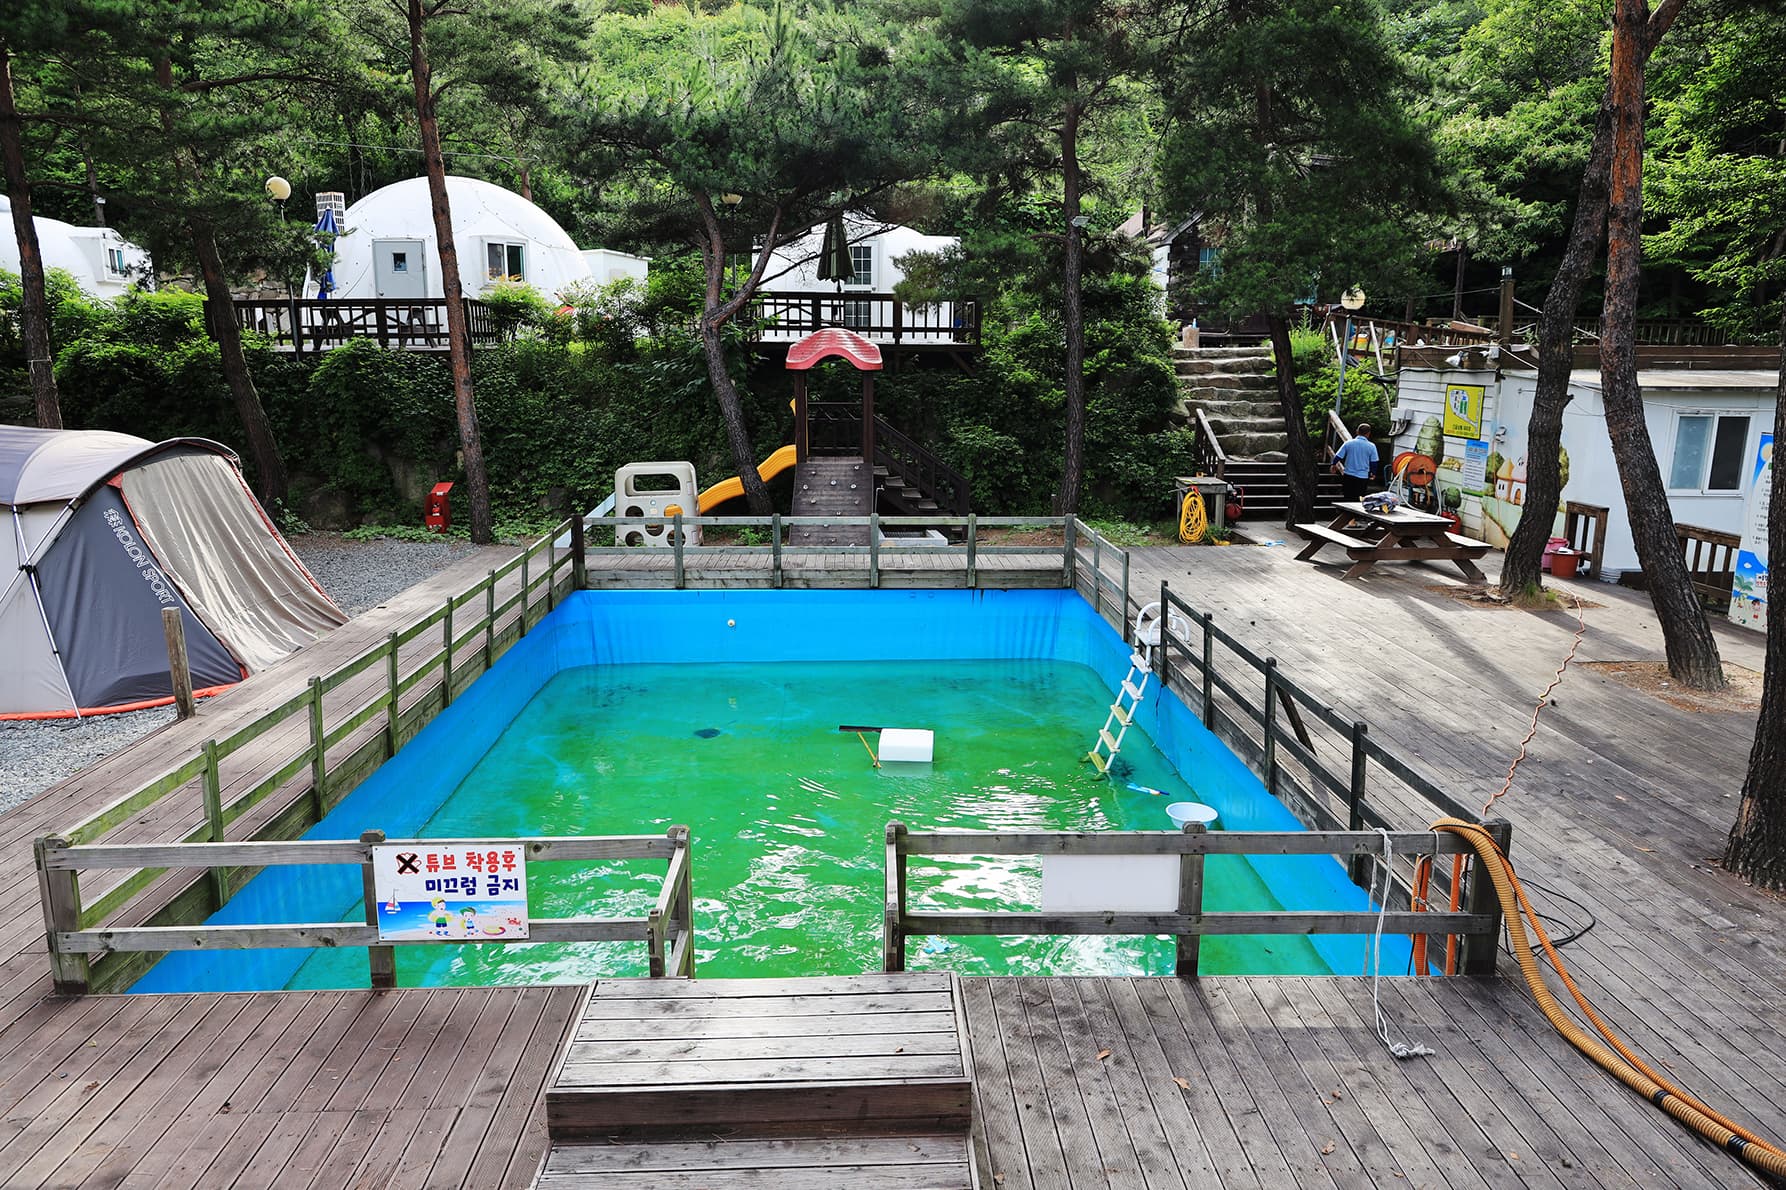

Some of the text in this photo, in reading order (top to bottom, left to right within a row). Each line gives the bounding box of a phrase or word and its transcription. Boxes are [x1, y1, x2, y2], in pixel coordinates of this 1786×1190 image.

[113, 525, 175, 604] KOLON SPORT
[425, 850, 517, 873] 튜브 착용후
[425, 875, 519, 897] 미끄럼 금지
